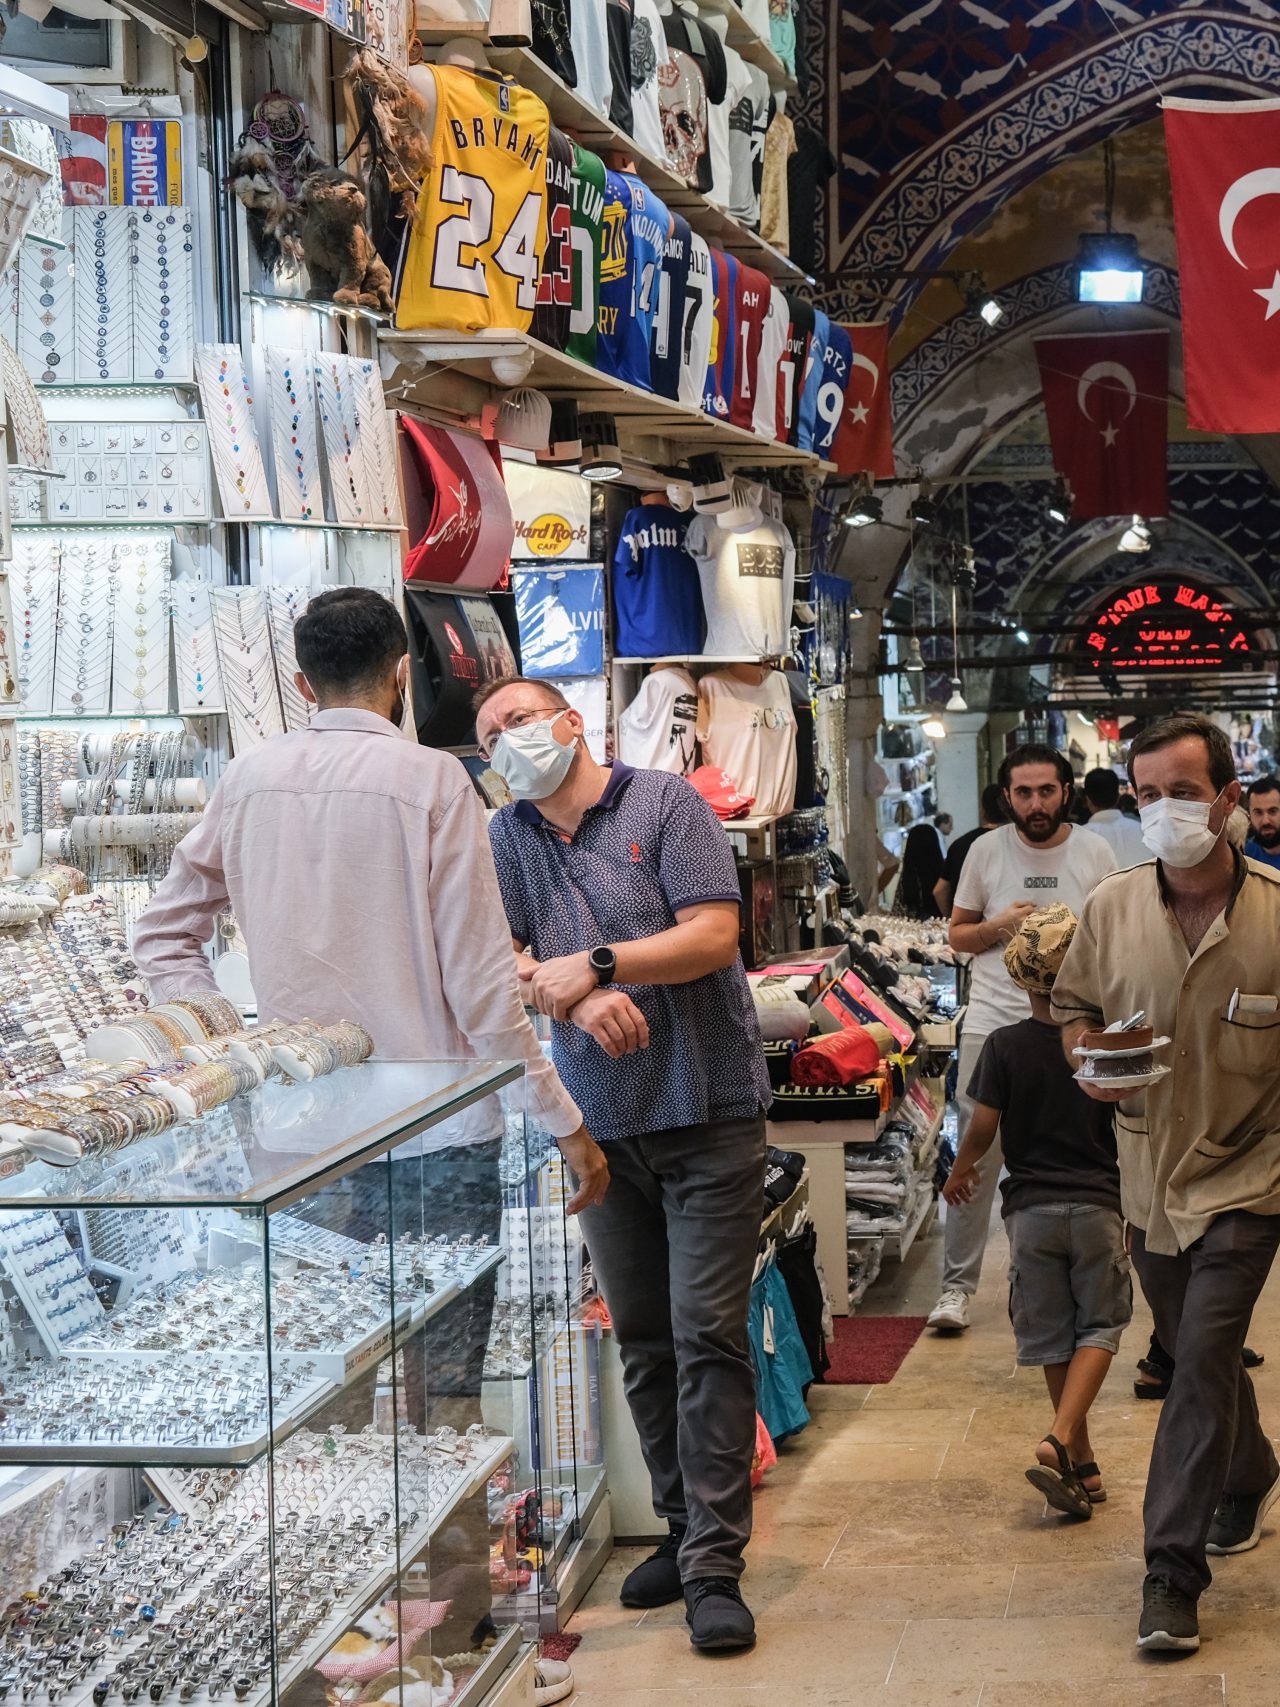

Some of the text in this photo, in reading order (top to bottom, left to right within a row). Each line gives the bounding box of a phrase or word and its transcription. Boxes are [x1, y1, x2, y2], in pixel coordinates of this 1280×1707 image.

[450, 117, 543, 171] BRYANT
[430, 163, 543, 313] 24
[662, 238, 684, 260] AMOS
[597, 306, 620, 336] RY
[823, 346, 847, 378] RTZ
[817, 381, 845, 448] 9
[514, 520, 588, 545] Hard Rock
[622, 522, 678, 562] palm
[572, 610, 603, 630] LVI
[588, 1374, 599, 1404] HALA
